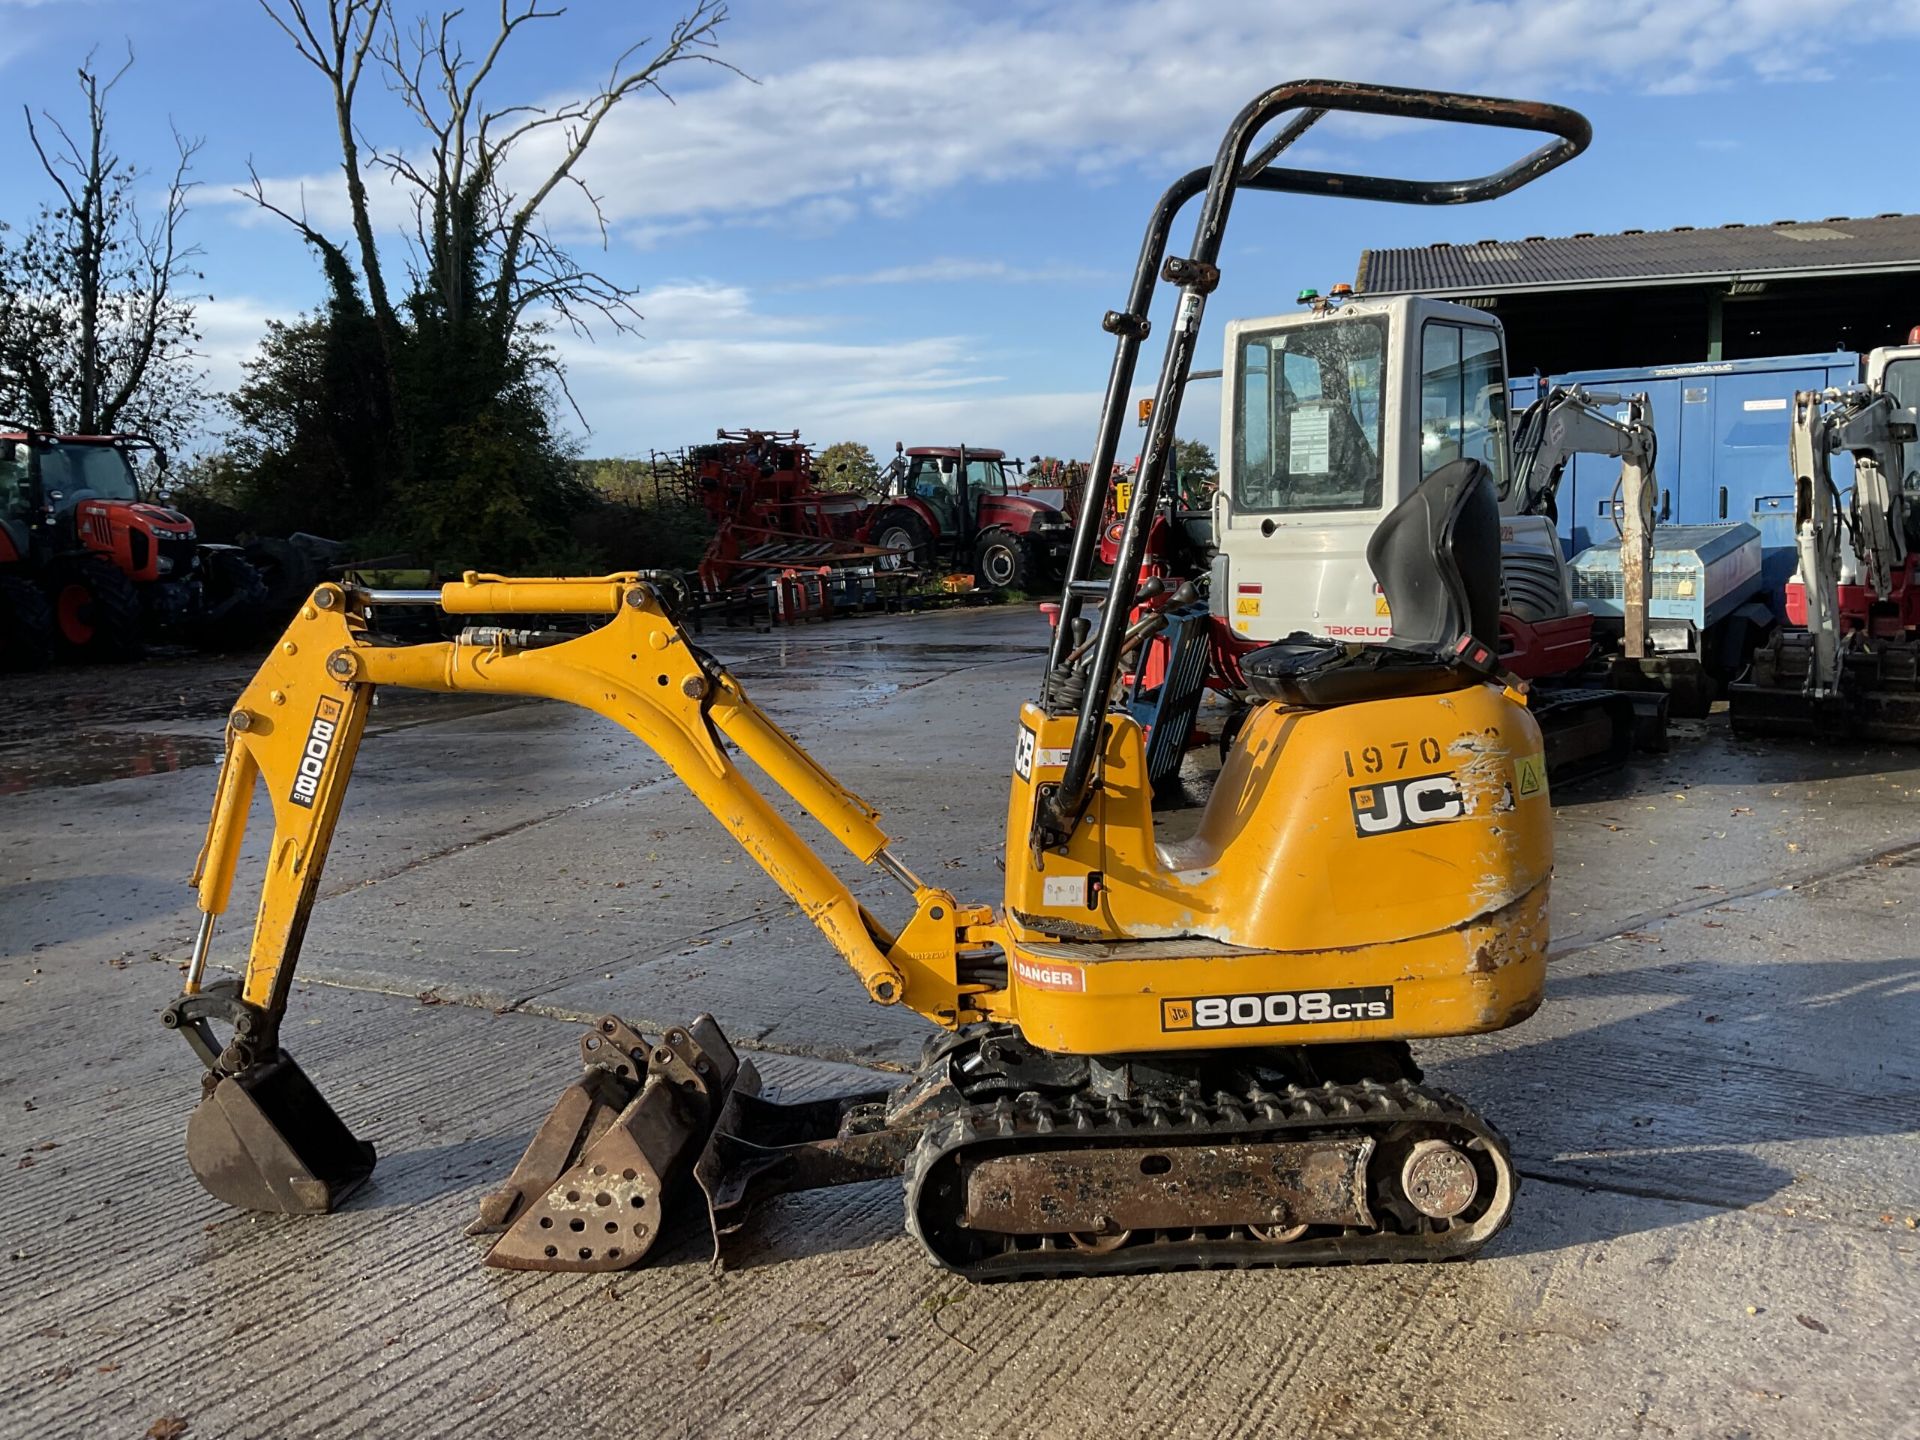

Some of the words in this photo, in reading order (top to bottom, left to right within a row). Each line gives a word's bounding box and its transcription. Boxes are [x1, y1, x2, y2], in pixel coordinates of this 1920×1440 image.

[295, 719, 335, 797] 8008
[1019, 962, 1073, 986] DANGER
[1169, 1006, 1191, 1024] JCB
[1195, 992, 1331, 1027] 8008
